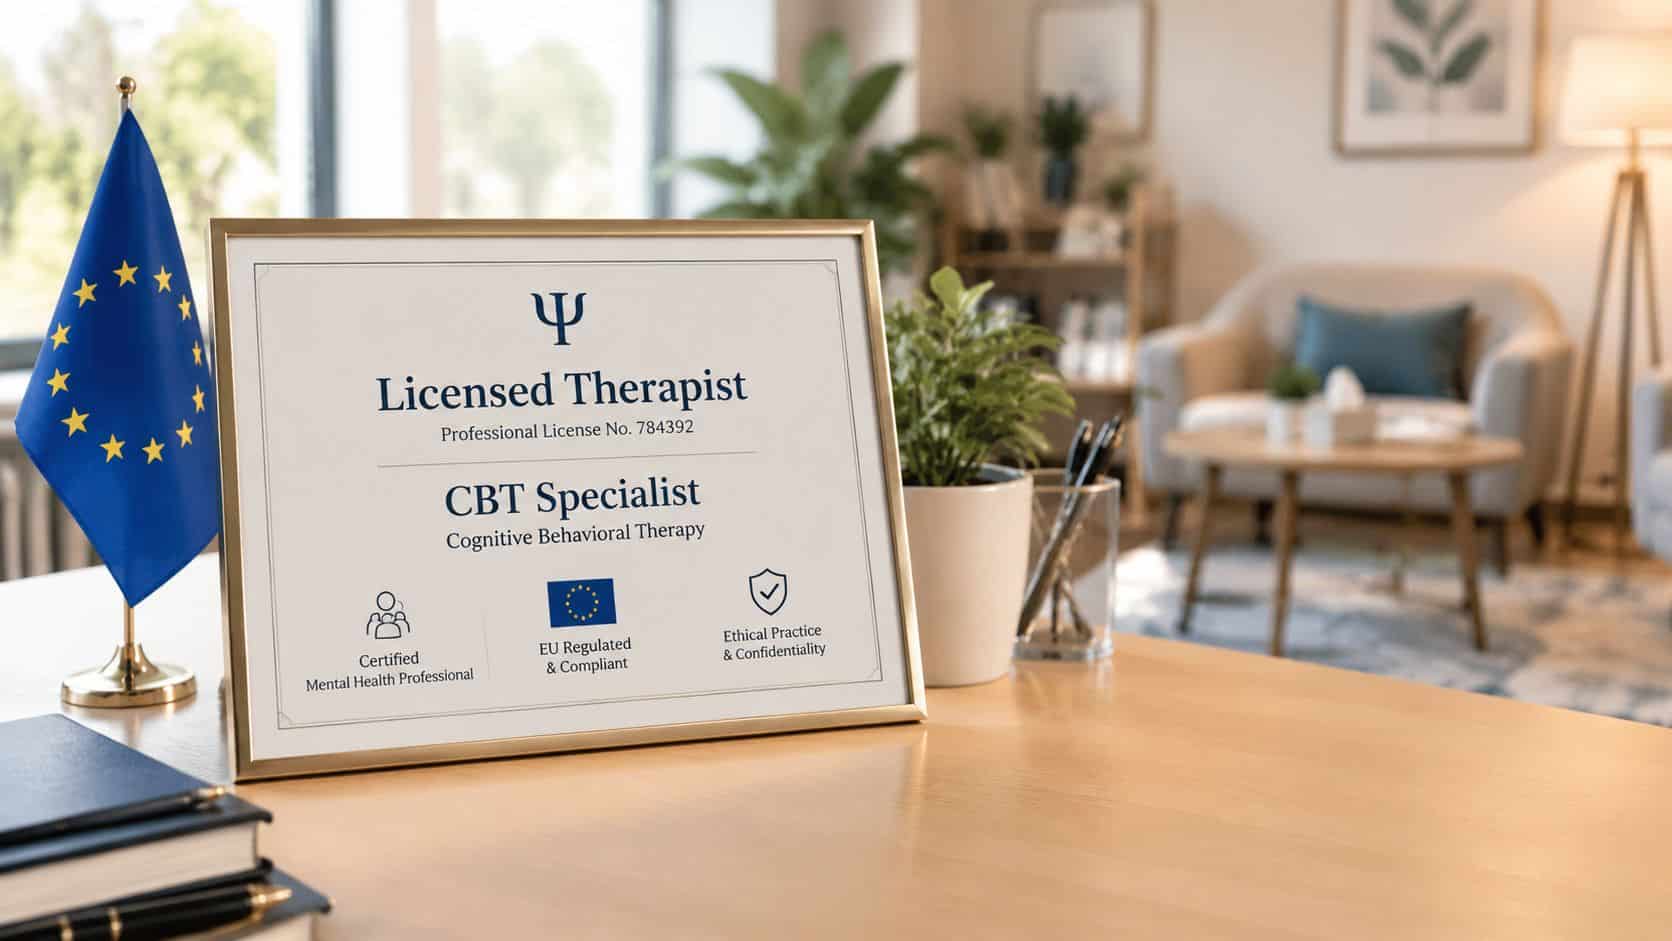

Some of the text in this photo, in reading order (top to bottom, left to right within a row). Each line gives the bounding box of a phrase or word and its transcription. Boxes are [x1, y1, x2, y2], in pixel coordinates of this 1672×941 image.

[375, 368, 749, 412] Licensed Therapist
[441, 419, 695, 442] Professional License No. 784392
[445, 476, 702, 522] CBT Specialist
[446, 522, 705, 553] Cognitive Behavioral Therapy
[723, 624, 822, 643] Ethical Practice
[539, 636, 633, 657] EU Regulated
[723, 641, 826, 662] & Confidentiality
[359, 650, 420, 669] Certified
[546, 657, 629, 675] & Compliant
[305, 667, 474, 693] Mental Health Professional
